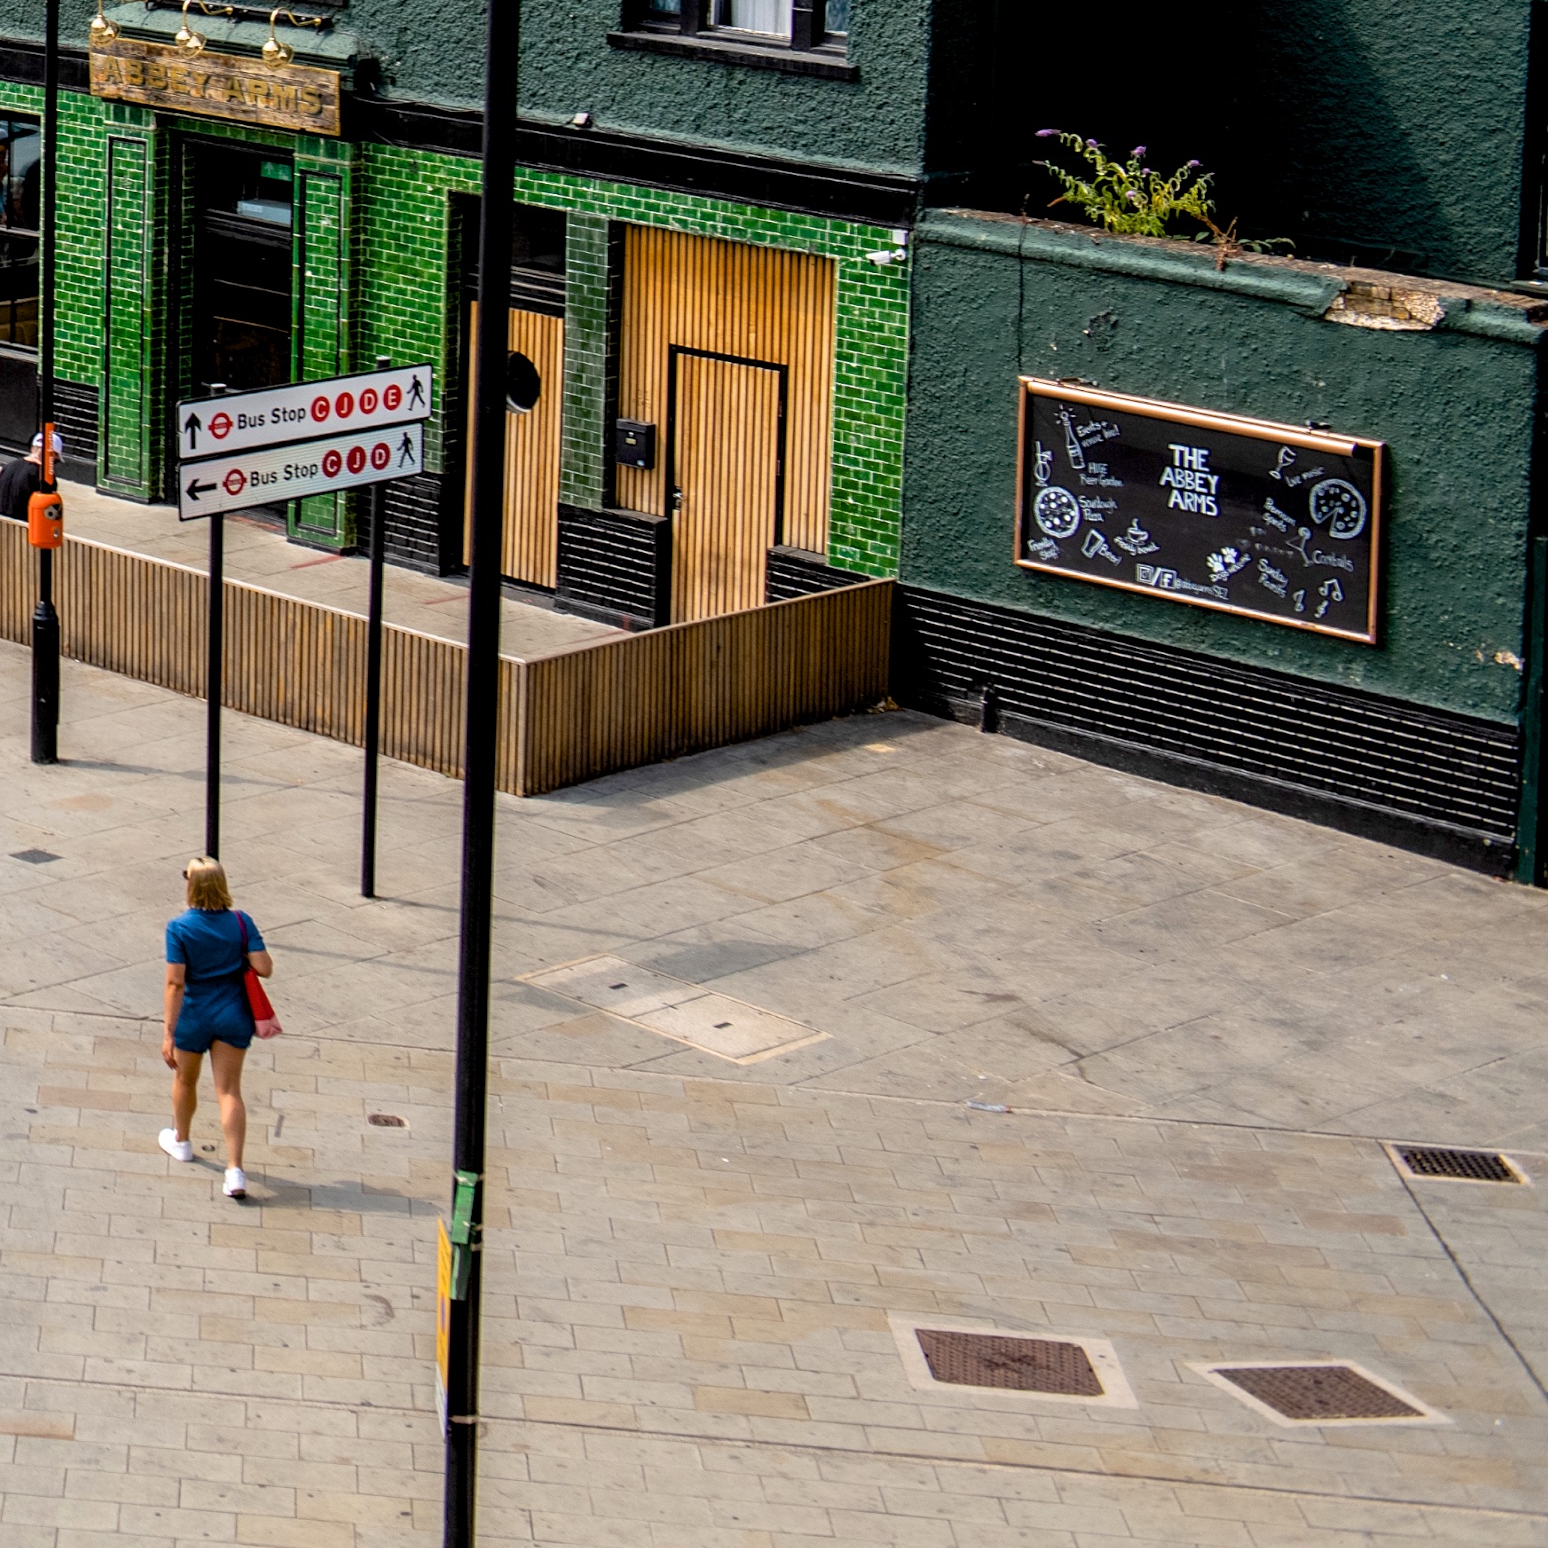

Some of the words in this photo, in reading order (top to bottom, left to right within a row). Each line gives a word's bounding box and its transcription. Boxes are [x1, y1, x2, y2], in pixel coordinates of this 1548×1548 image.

[104, 54, 210, 99] ABBEY
[222, 76, 324, 117] ARMS
[237, 412, 265, 430] Bus
[270, 406, 306, 425] Stop
[315, 400, 327, 418] C
[364, 392, 376, 409] D
[250, 470, 278, 488] Bus
[283, 463, 319, 481] Stop
[326, 455, 338, 473] C
[375, 448, 387, 465] D
[1167, 443, 1210, 472] THE
[1159, 466, 1220, 495] ABBEY
[1167, 488, 1219, 517] ARMS
[1263, 496, 1297, 527] Premium
